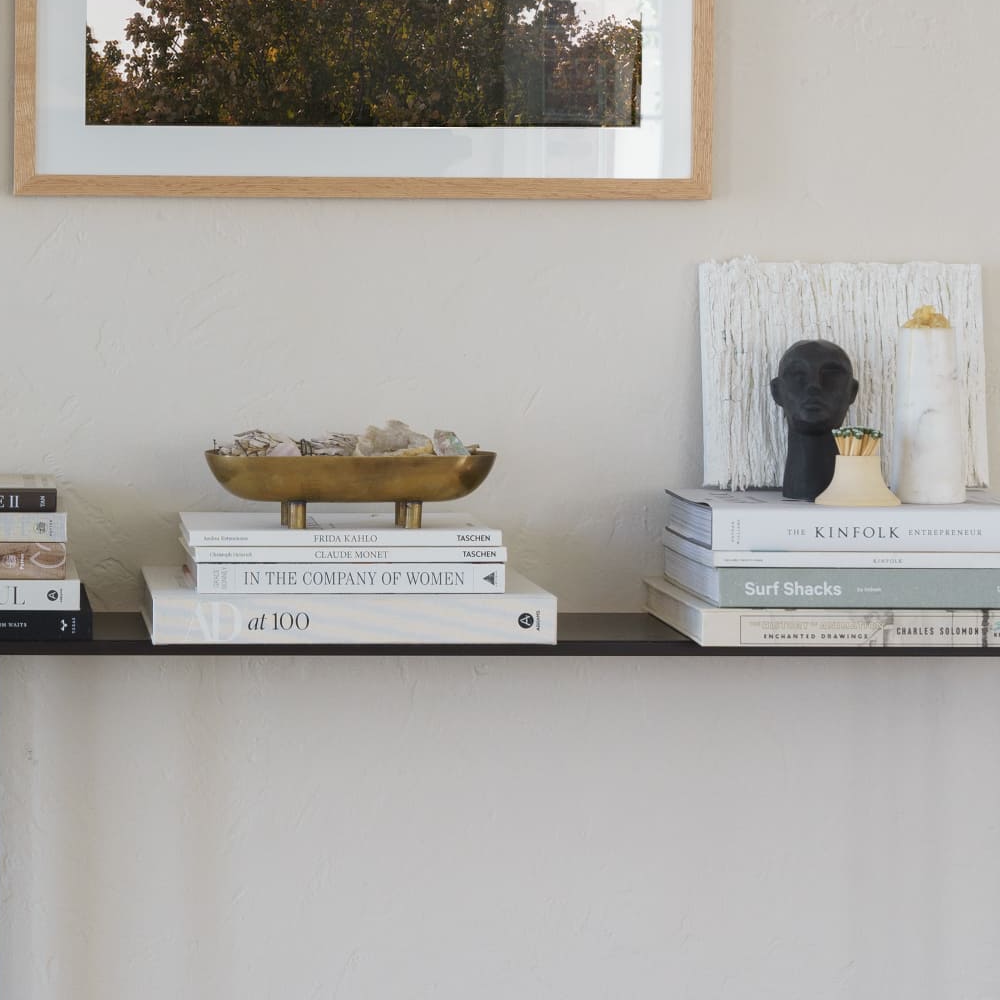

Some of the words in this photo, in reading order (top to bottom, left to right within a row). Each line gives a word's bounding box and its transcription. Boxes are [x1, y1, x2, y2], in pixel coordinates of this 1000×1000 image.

[9, 495, 19, 508] II
[457, 534, 491, 542] TASCHEN
[787, 528, 806, 536] THE
[815, 526, 900, 539] KINFOLK
[313, 534, 342, 543] FRIDA
[344, 534, 378, 543] KAHLO
[314, 551, 352, 559] CLAUDE
[354, 551, 389, 559] MONET
[462, 550, 497, 558] TASCHEN
[244, 571, 260, 586] IN
[265, 571, 297, 586] THE
[302, 571, 377, 586] COMPANY
[381, 571, 401, 586] OF
[406, 571, 465, 586] WOMEN
[744, 581, 780, 596] Surf
[783, 581, 842, 596] Shacks
[185, 601, 242, 641] AD
[247, 613, 268, 631] at
[272, 612, 310, 631] 100
[896, 627, 935, 635] CHARLES
[939, 627, 979, 635] SOLOMON
